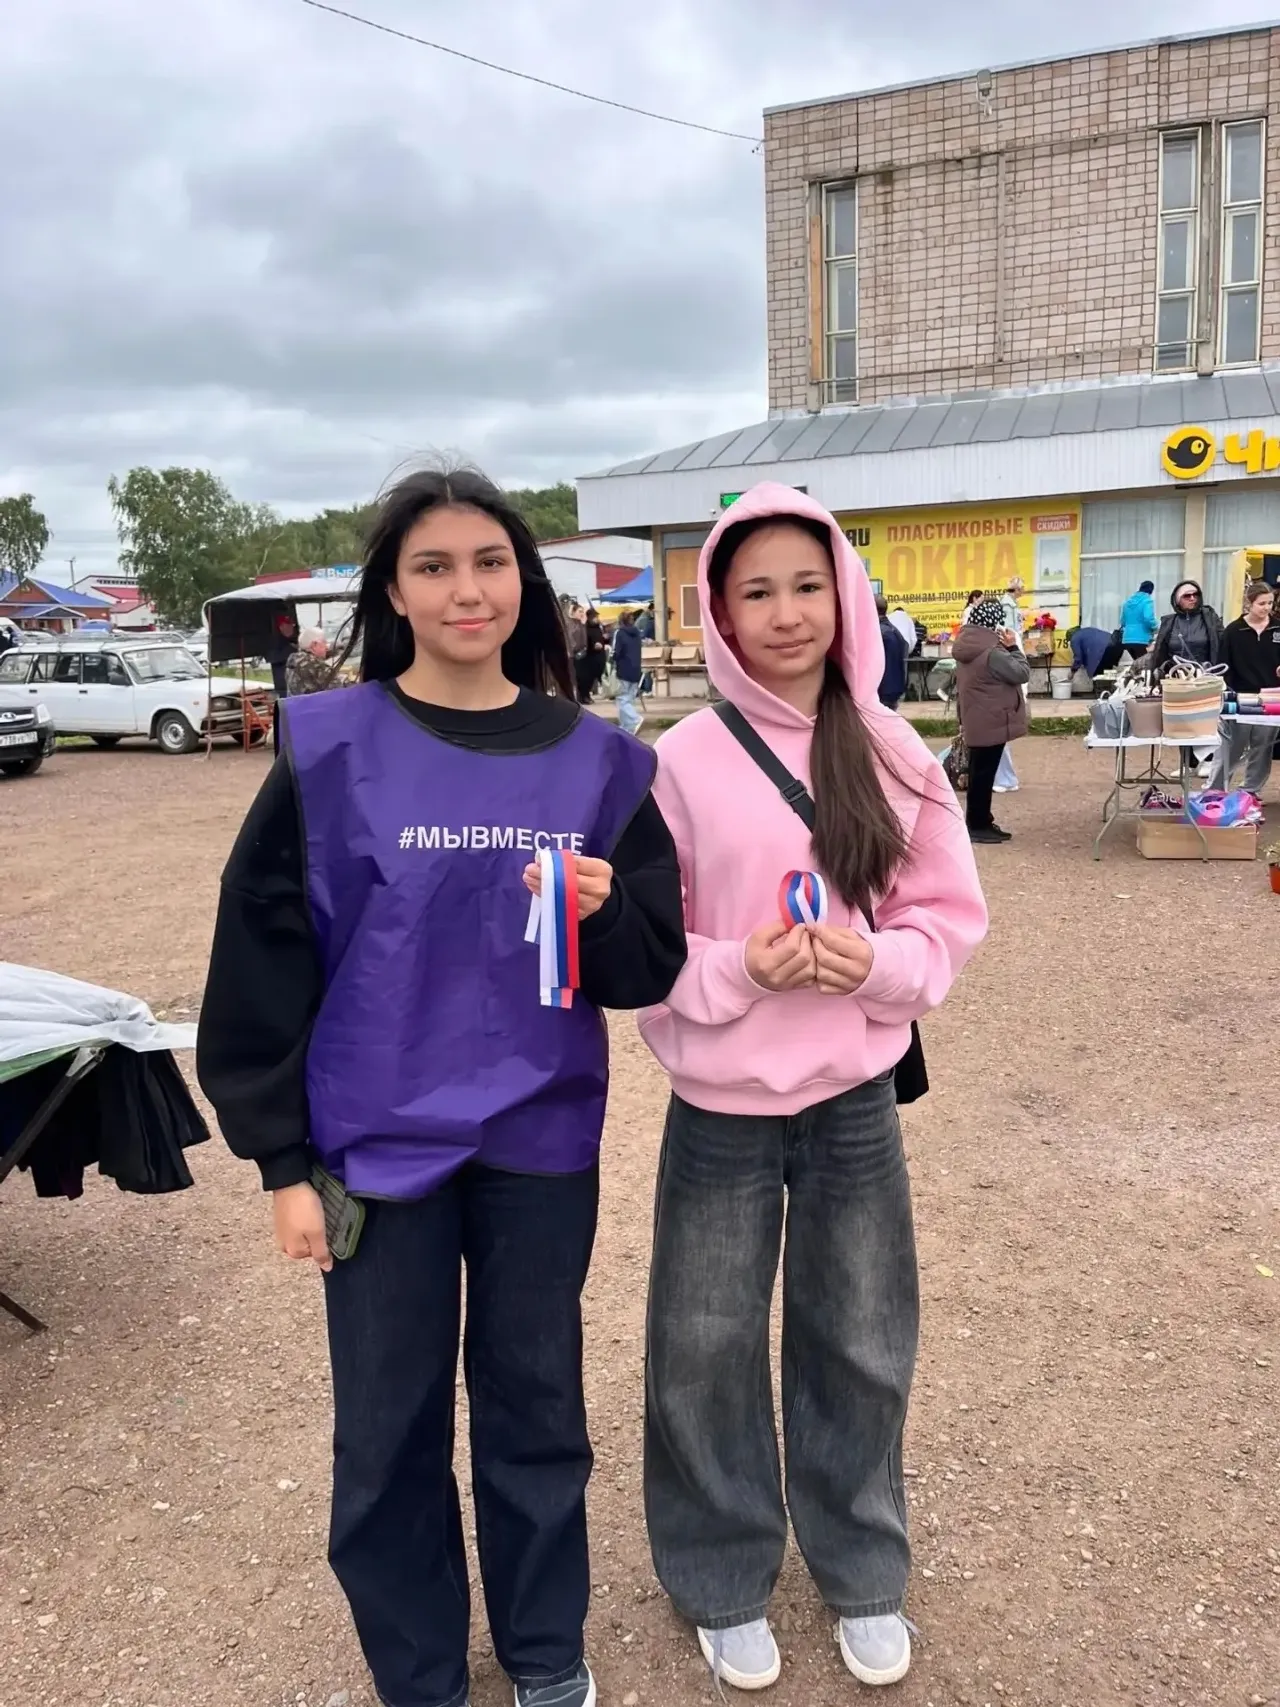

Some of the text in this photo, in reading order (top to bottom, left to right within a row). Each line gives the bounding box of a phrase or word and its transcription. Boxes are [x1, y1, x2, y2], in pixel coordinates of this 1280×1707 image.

[887, 517, 1023, 543] ПЛАСТИКОВЫЕ
[887, 540, 1020, 592] ОКНА
[398, 825, 585, 856] #МЫВМЕСТЕ
